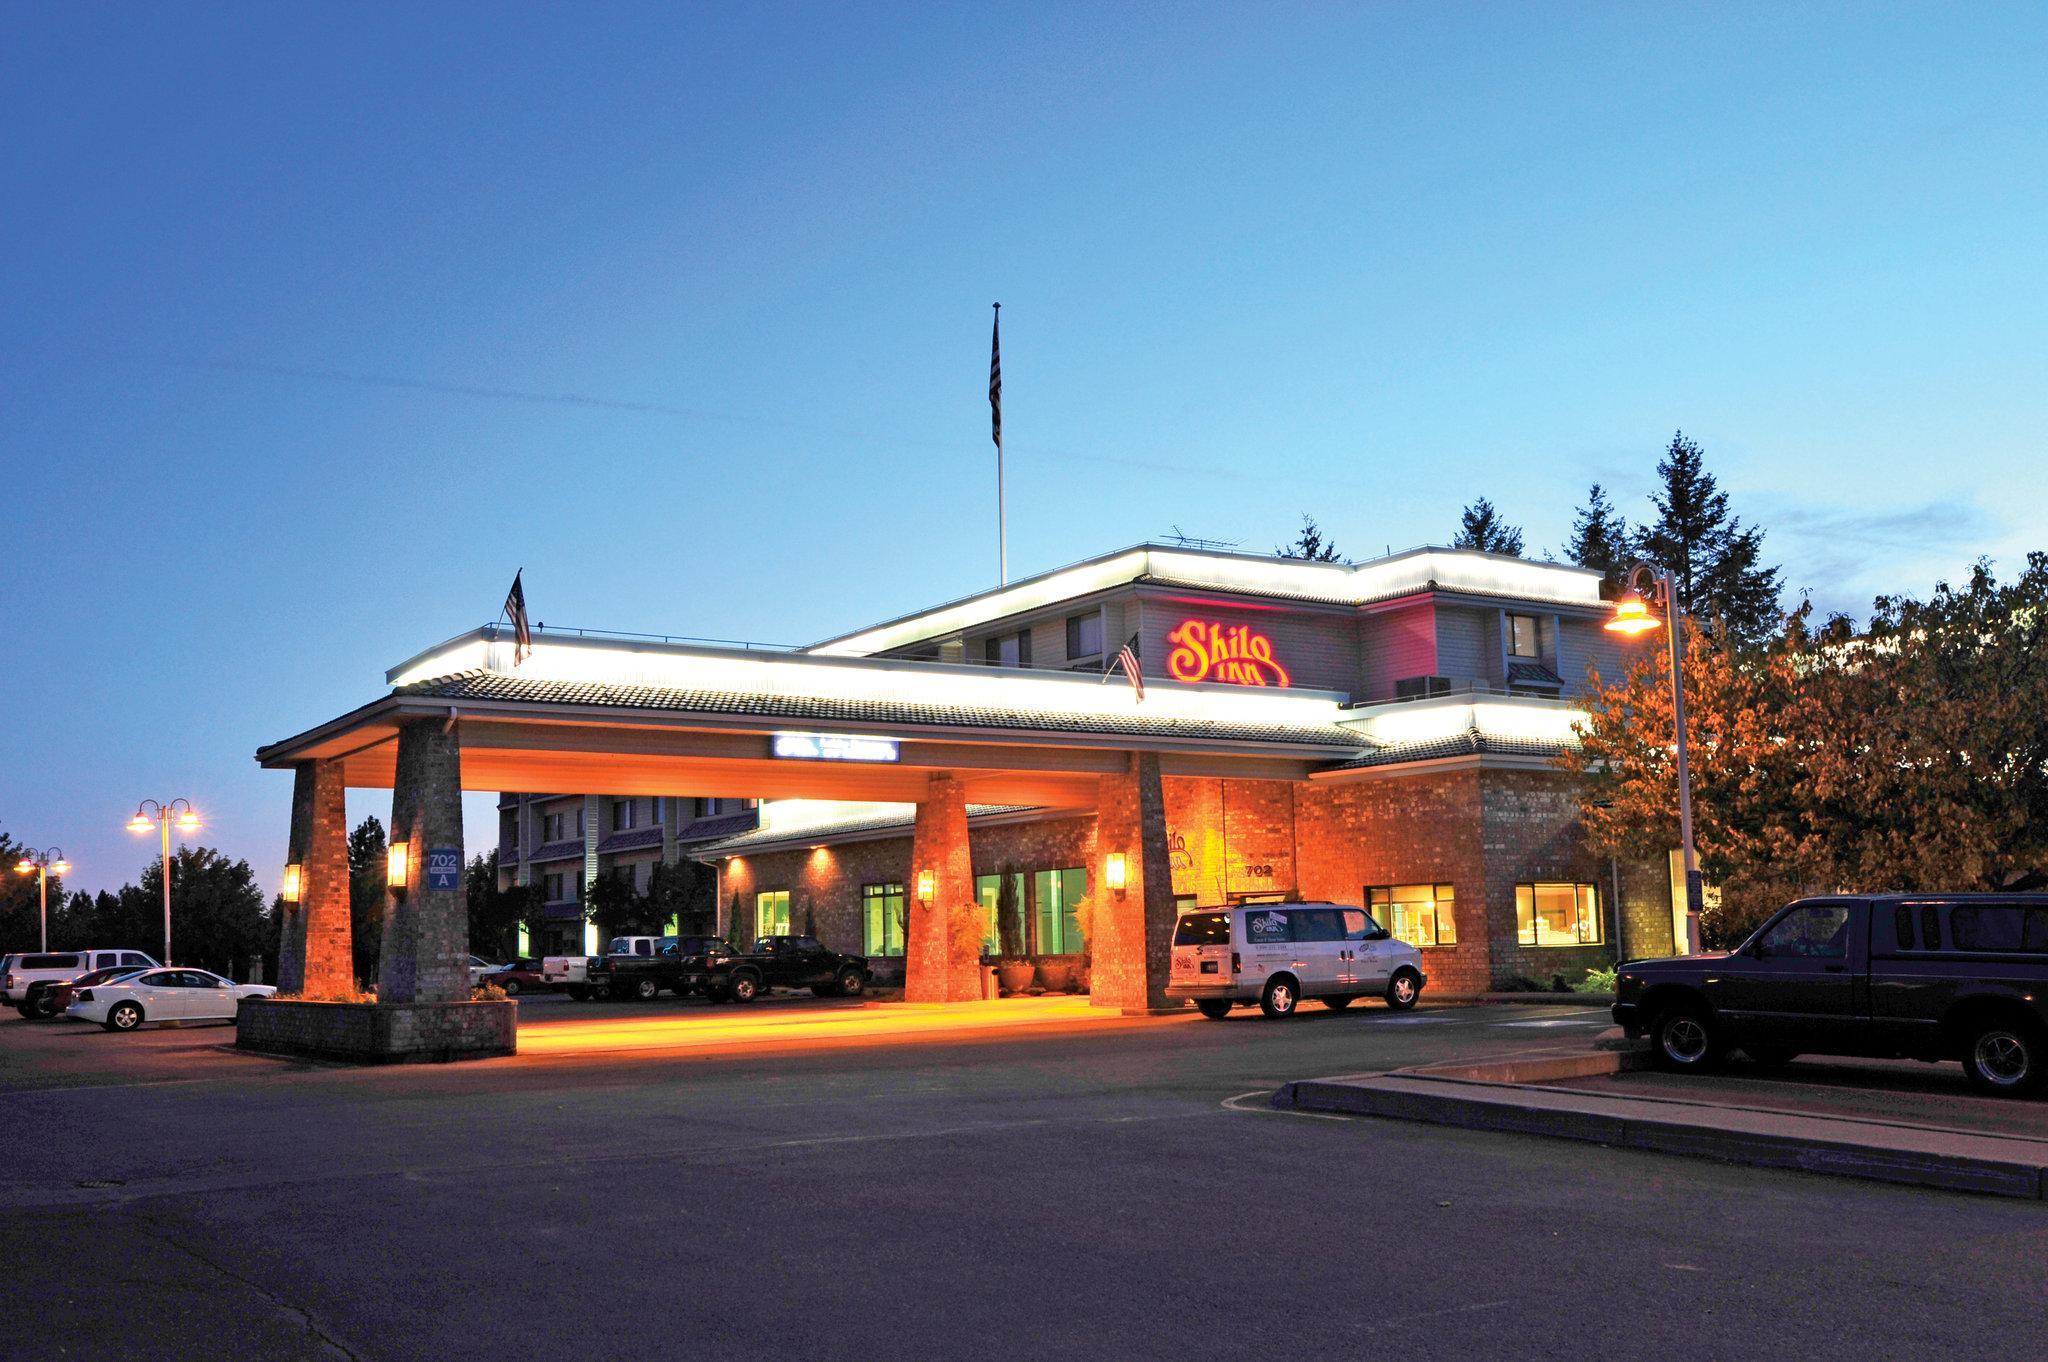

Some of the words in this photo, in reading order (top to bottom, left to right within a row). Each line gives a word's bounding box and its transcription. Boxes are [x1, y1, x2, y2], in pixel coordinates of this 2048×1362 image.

[1168, 619, 1290, 688] Shilo
[430, 854, 457, 867] 702
[1245, 865, 1273, 878] 702
[438, 874, 449, 886] A
